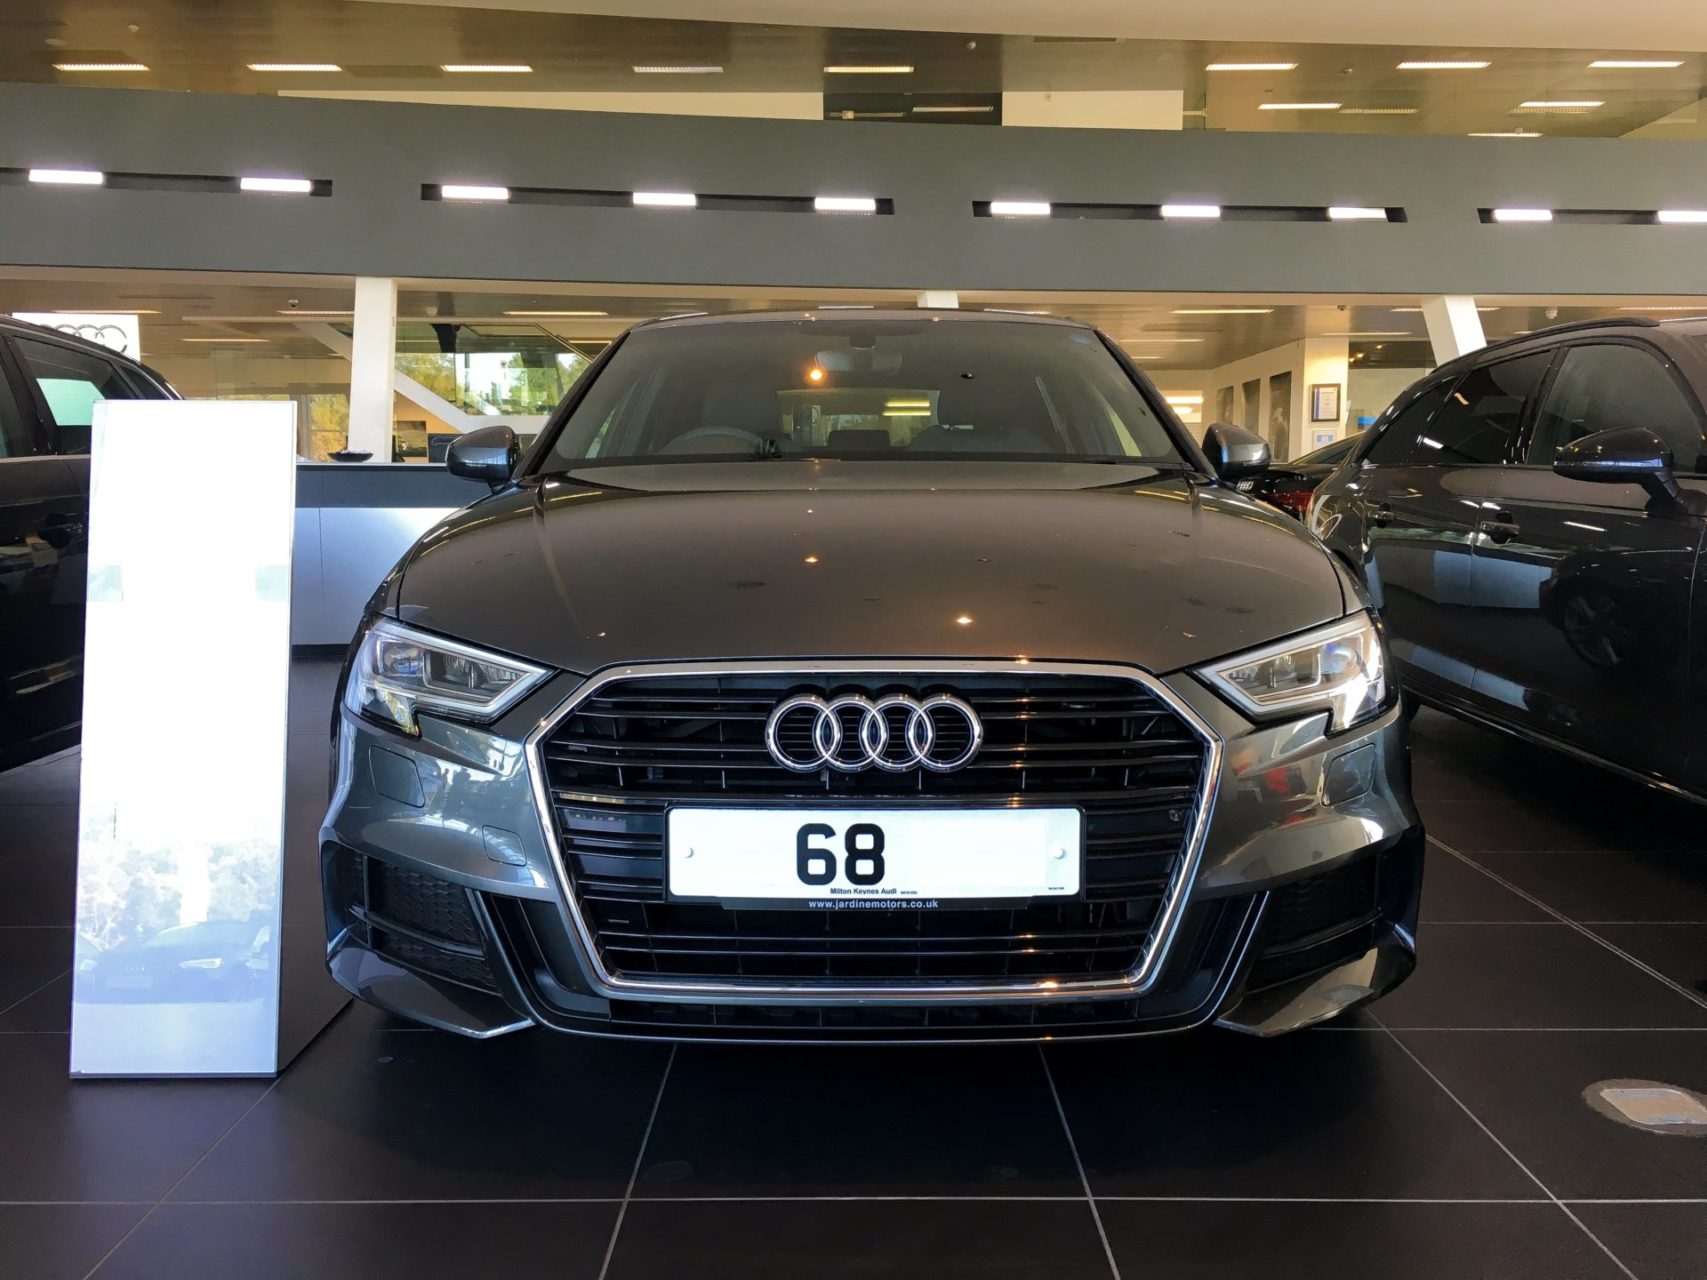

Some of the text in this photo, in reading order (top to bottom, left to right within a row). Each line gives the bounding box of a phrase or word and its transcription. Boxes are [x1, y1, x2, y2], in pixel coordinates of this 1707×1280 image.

[796, 823, 885, 886] 68
[830, 887, 852, 895] Milton
[853, 887, 879, 895] Keynes
[880, 887, 897, 895] Audi
[808, 899, 938, 911] www.jardinemotors.co.uk
